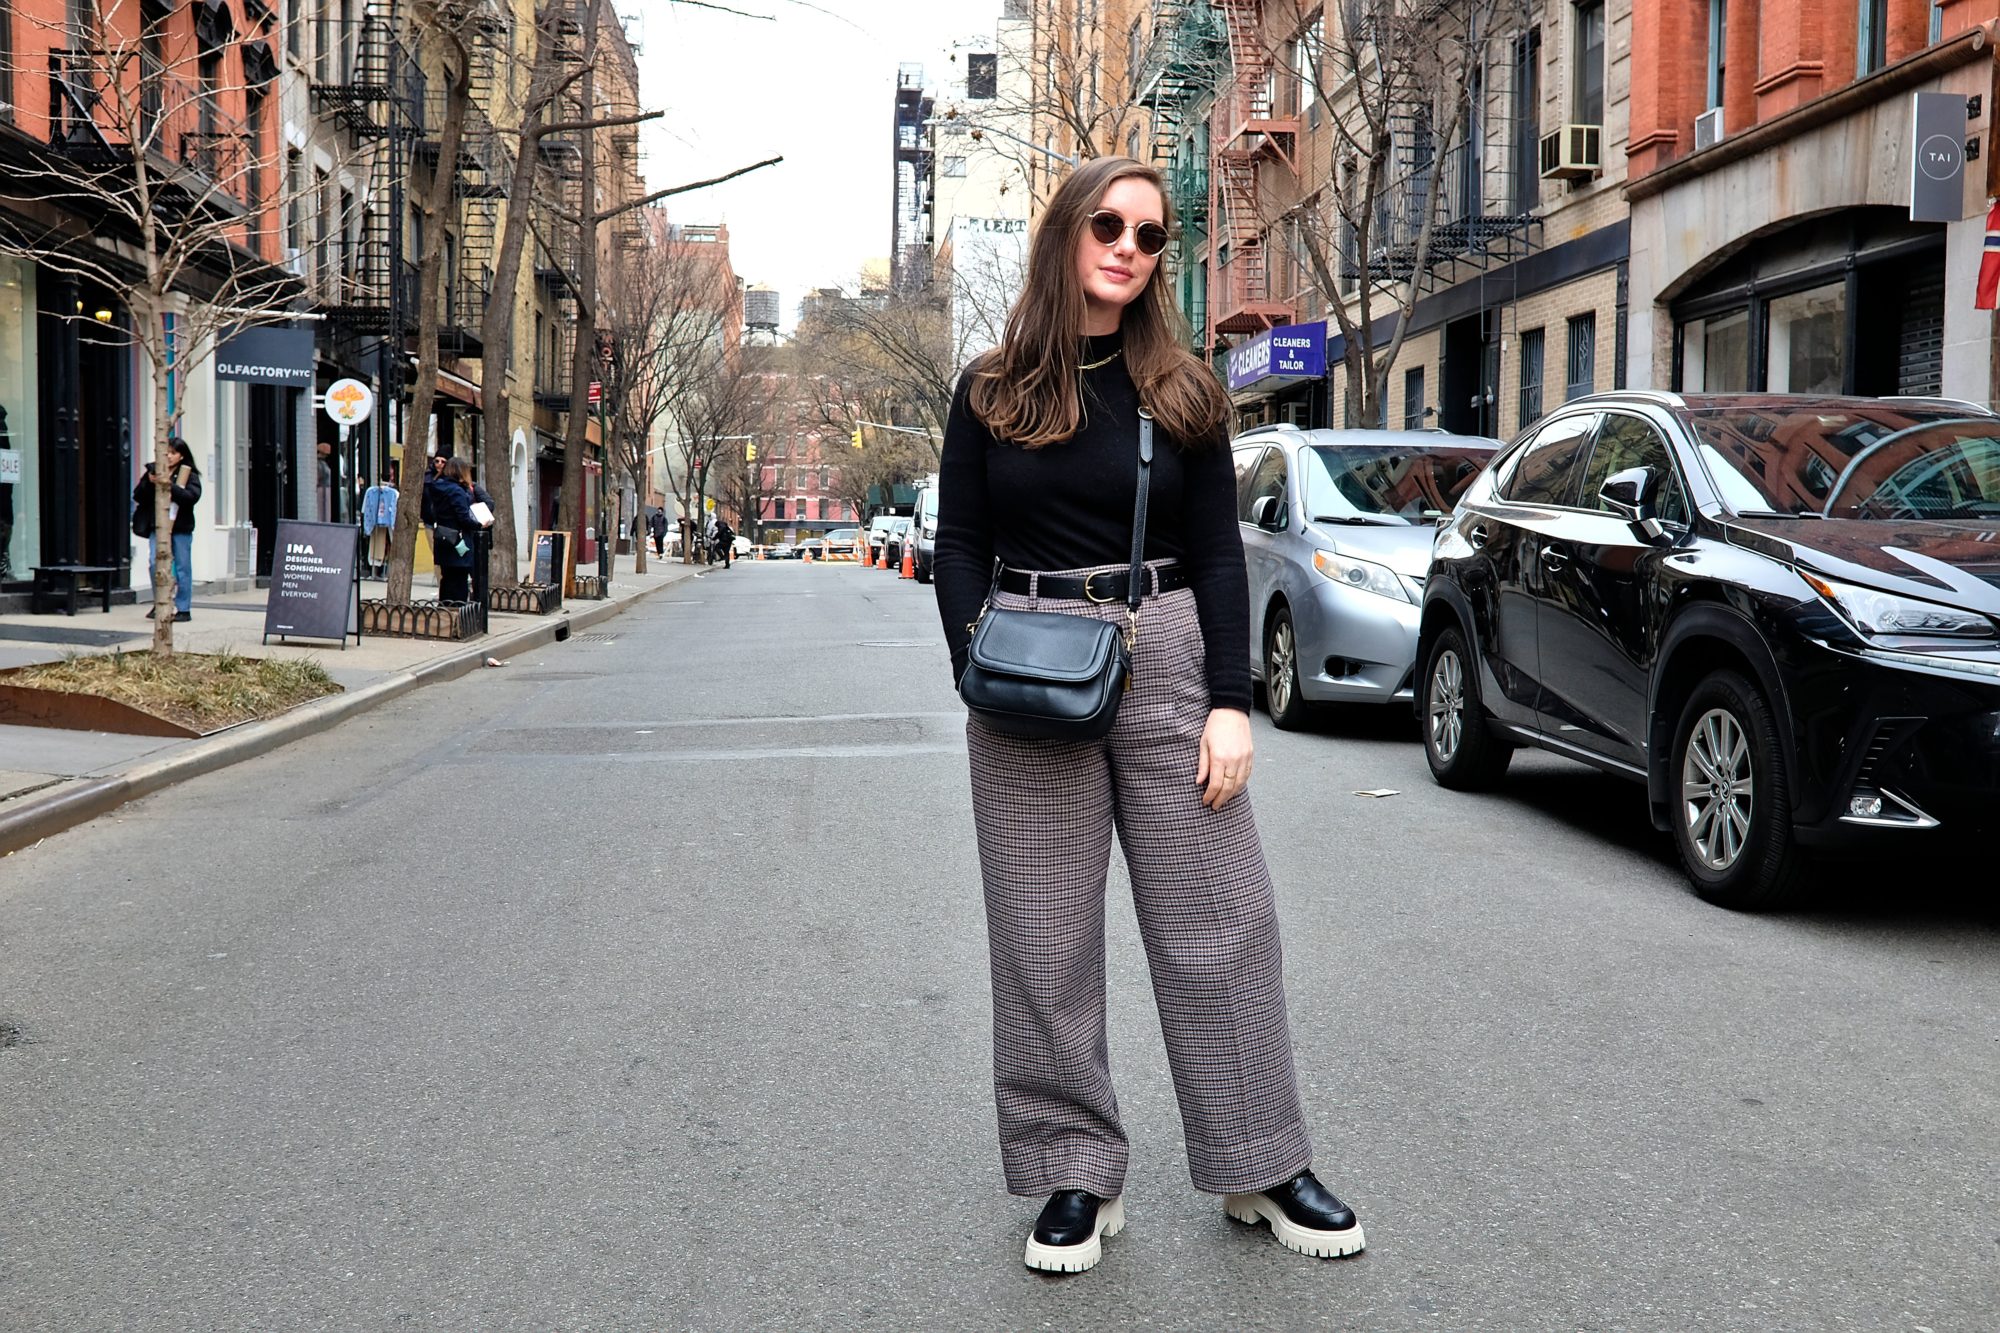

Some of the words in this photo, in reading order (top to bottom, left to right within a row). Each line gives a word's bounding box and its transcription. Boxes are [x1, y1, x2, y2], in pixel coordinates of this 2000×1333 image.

[1929, 152, 1950, 162] TAI
[1273, 337, 1311, 348] CLEANERS
[1238, 339, 1270, 376] CLEANERS
[1289, 349, 1294, 358] &
[1279, 360, 1304, 370] TAILOR
[217, 363, 291, 378] OLFACTORY
[292, 369, 311, 378] NYC
[287, 544, 314, 554] INA
[286, 556, 323, 564] DESIGNER
[284, 565, 342, 574] CONSIGNMENT
[281, 591, 318, 599] EVERYONE
